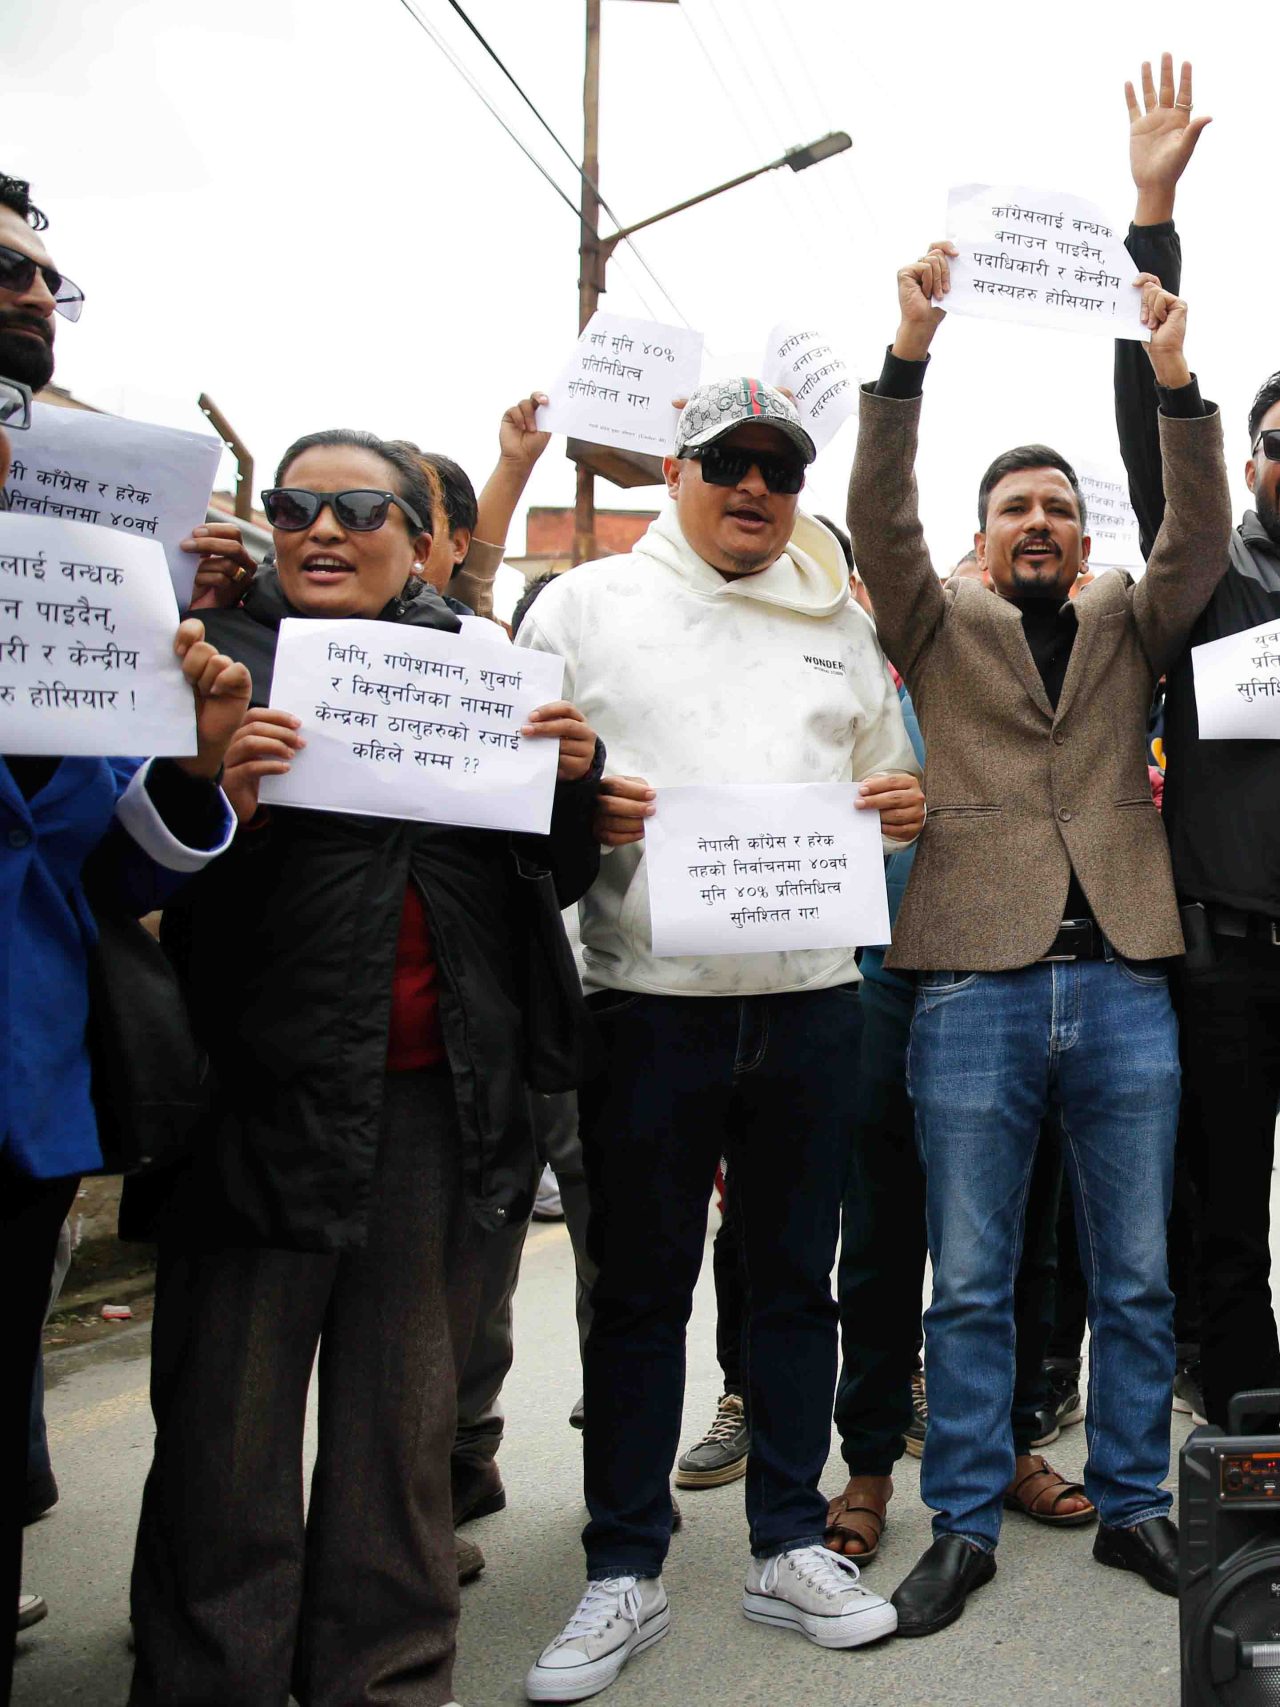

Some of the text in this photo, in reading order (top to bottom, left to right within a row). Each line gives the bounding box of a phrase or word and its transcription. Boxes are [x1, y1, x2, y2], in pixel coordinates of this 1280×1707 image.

[60, 562, 124, 586] वन्धक
[36, 596, 116, 634] पाइदैन्,
[42, 645, 56, 660] र
[68, 640, 140, 671] केन्द्रीय
[328, 642, 522, 691] बिपि, गणेशमान, शुवर्ण
[29, 680, 119, 709] होसियार
[331, 674, 514, 719] र किसुनजिका नाममा
[315, 701, 521, 751] केन्द्रका ठालुहरुको रजाई
[352, 739, 479, 774] कहिले सम्म ??
[697, 834, 740, 852] नेपाली
[793, 836, 801, 848] र
[807, 832, 834, 847] हरेक
[688, 854, 847, 878] तहको निर्वाचनमा ४०वर्ष
[699, 878, 841, 906] मुनि ४०% प्रतिनिधित्व
[797, 906, 819, 919] गर!
